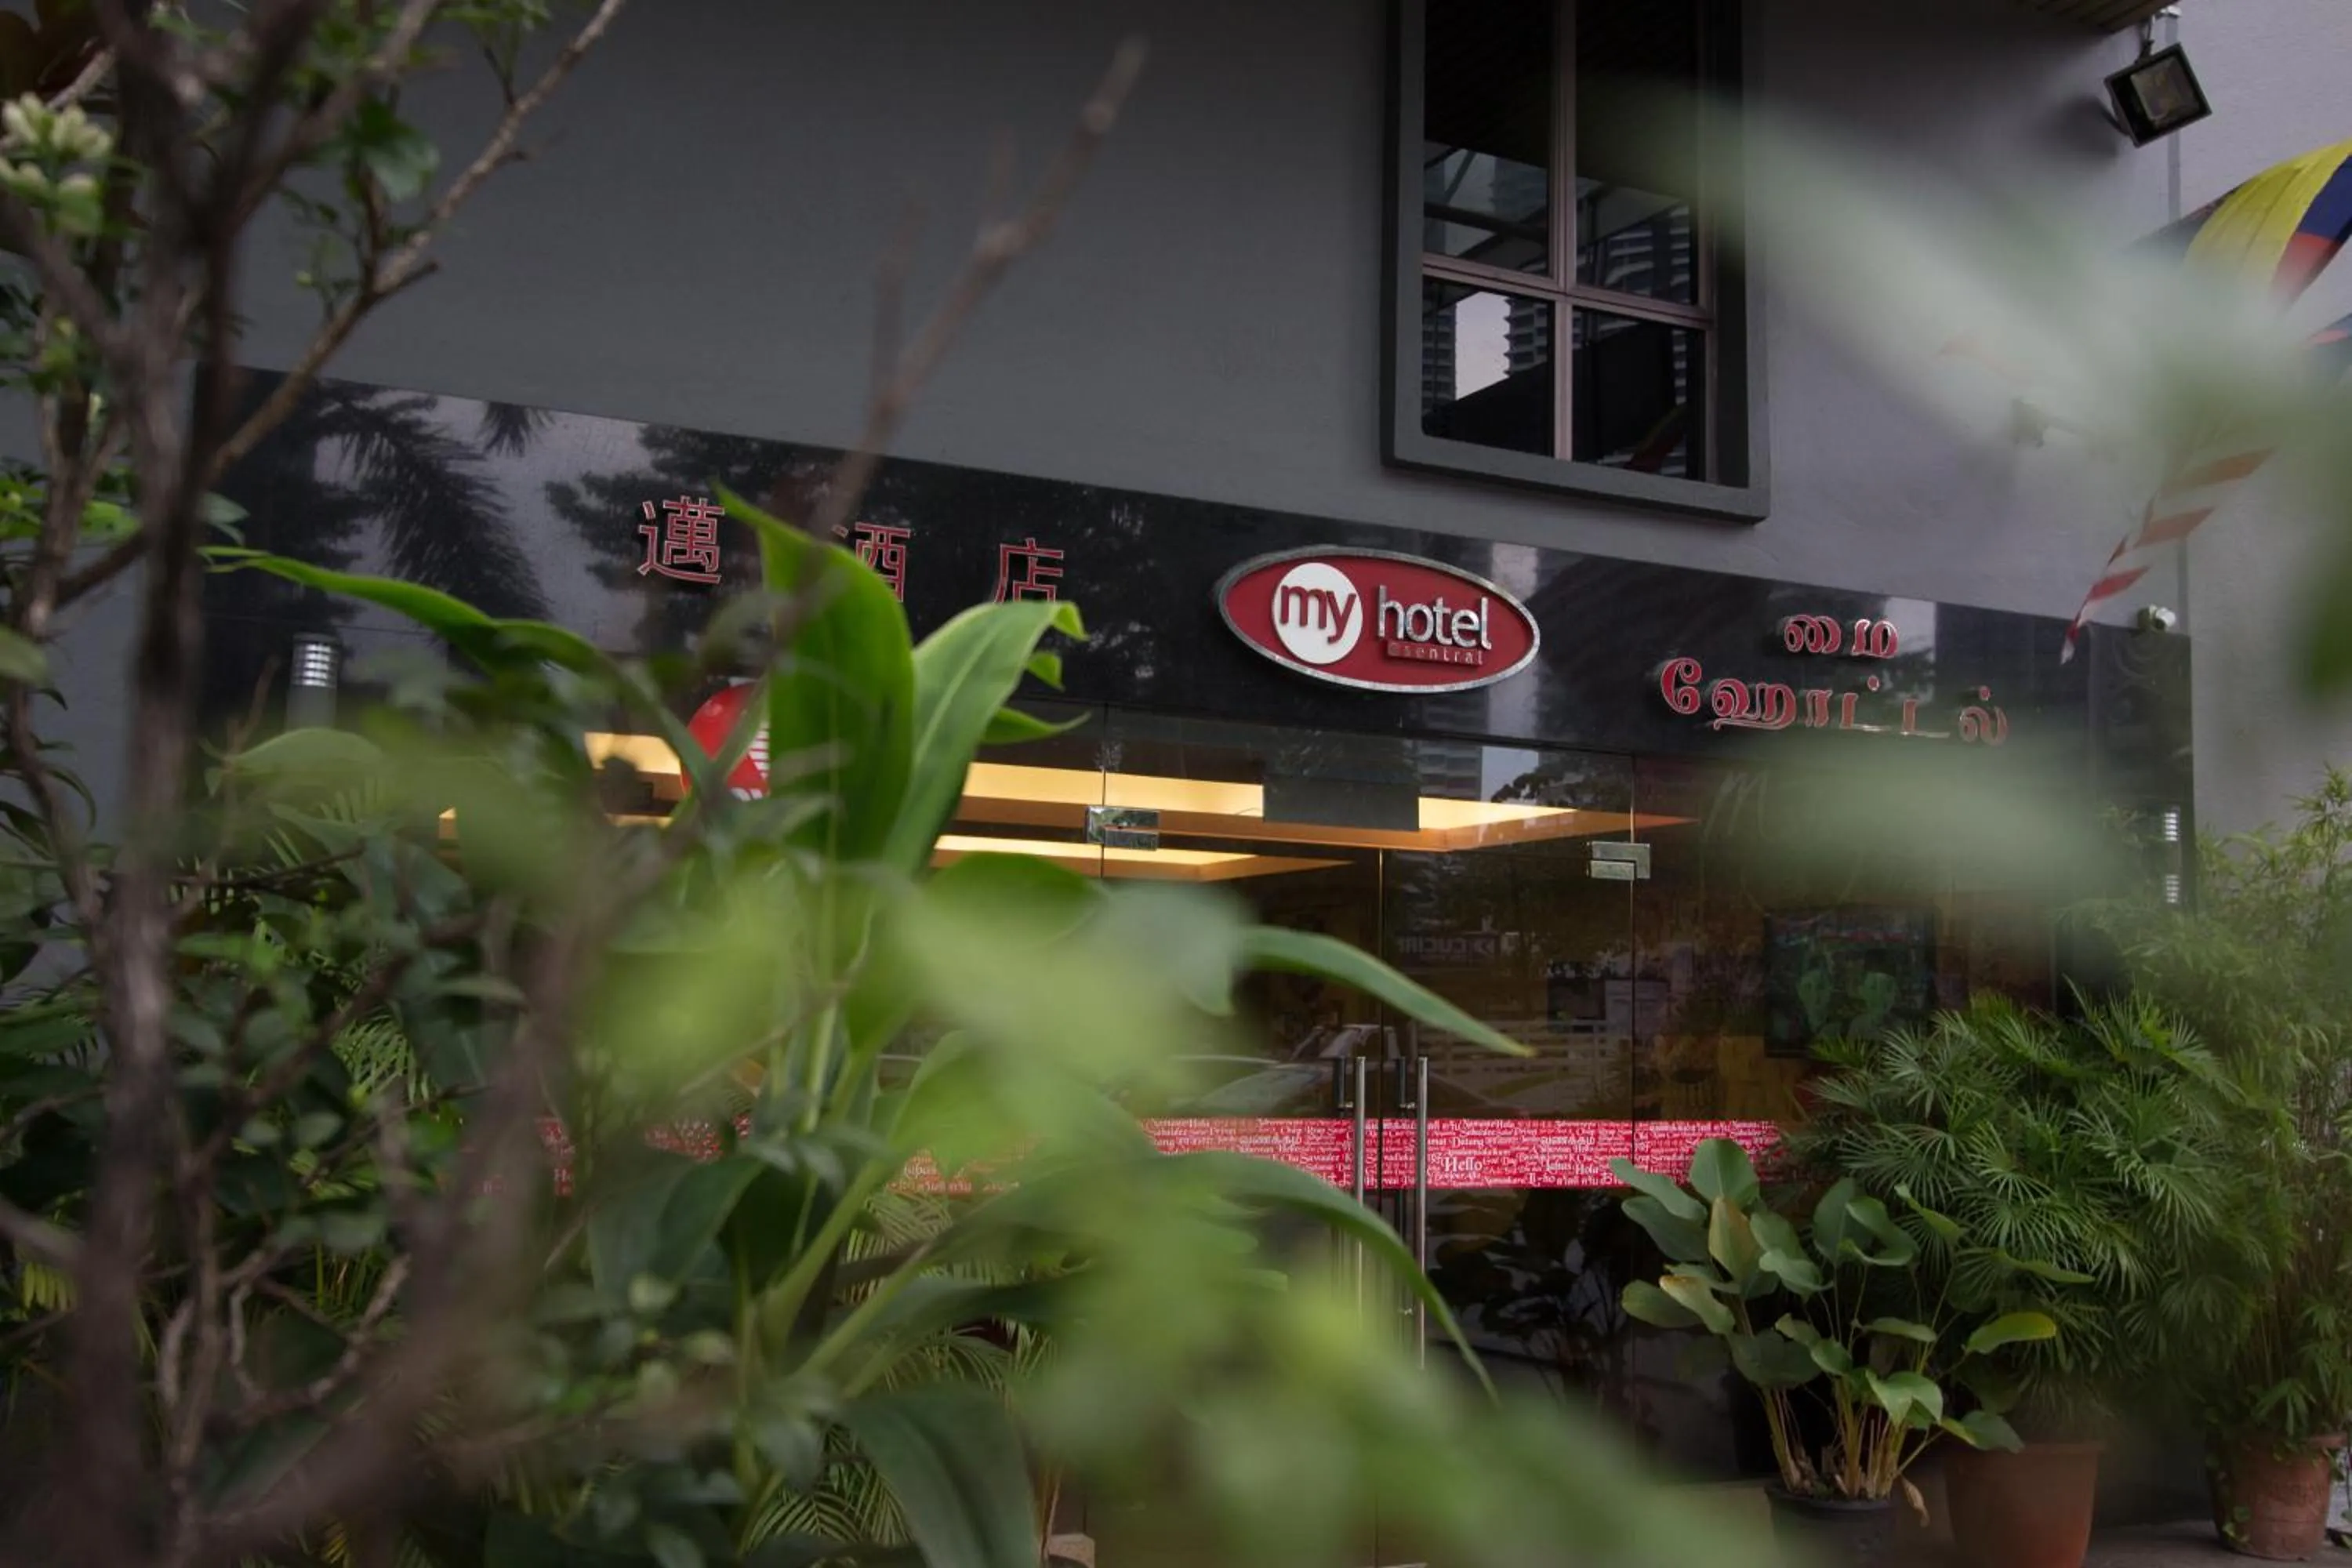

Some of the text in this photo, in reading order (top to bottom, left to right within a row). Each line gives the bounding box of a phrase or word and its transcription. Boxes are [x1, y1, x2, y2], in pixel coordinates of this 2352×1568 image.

[1279, 584, 1493, 650] my hotel
[1445, 1156, 1483, 1172] Hello
